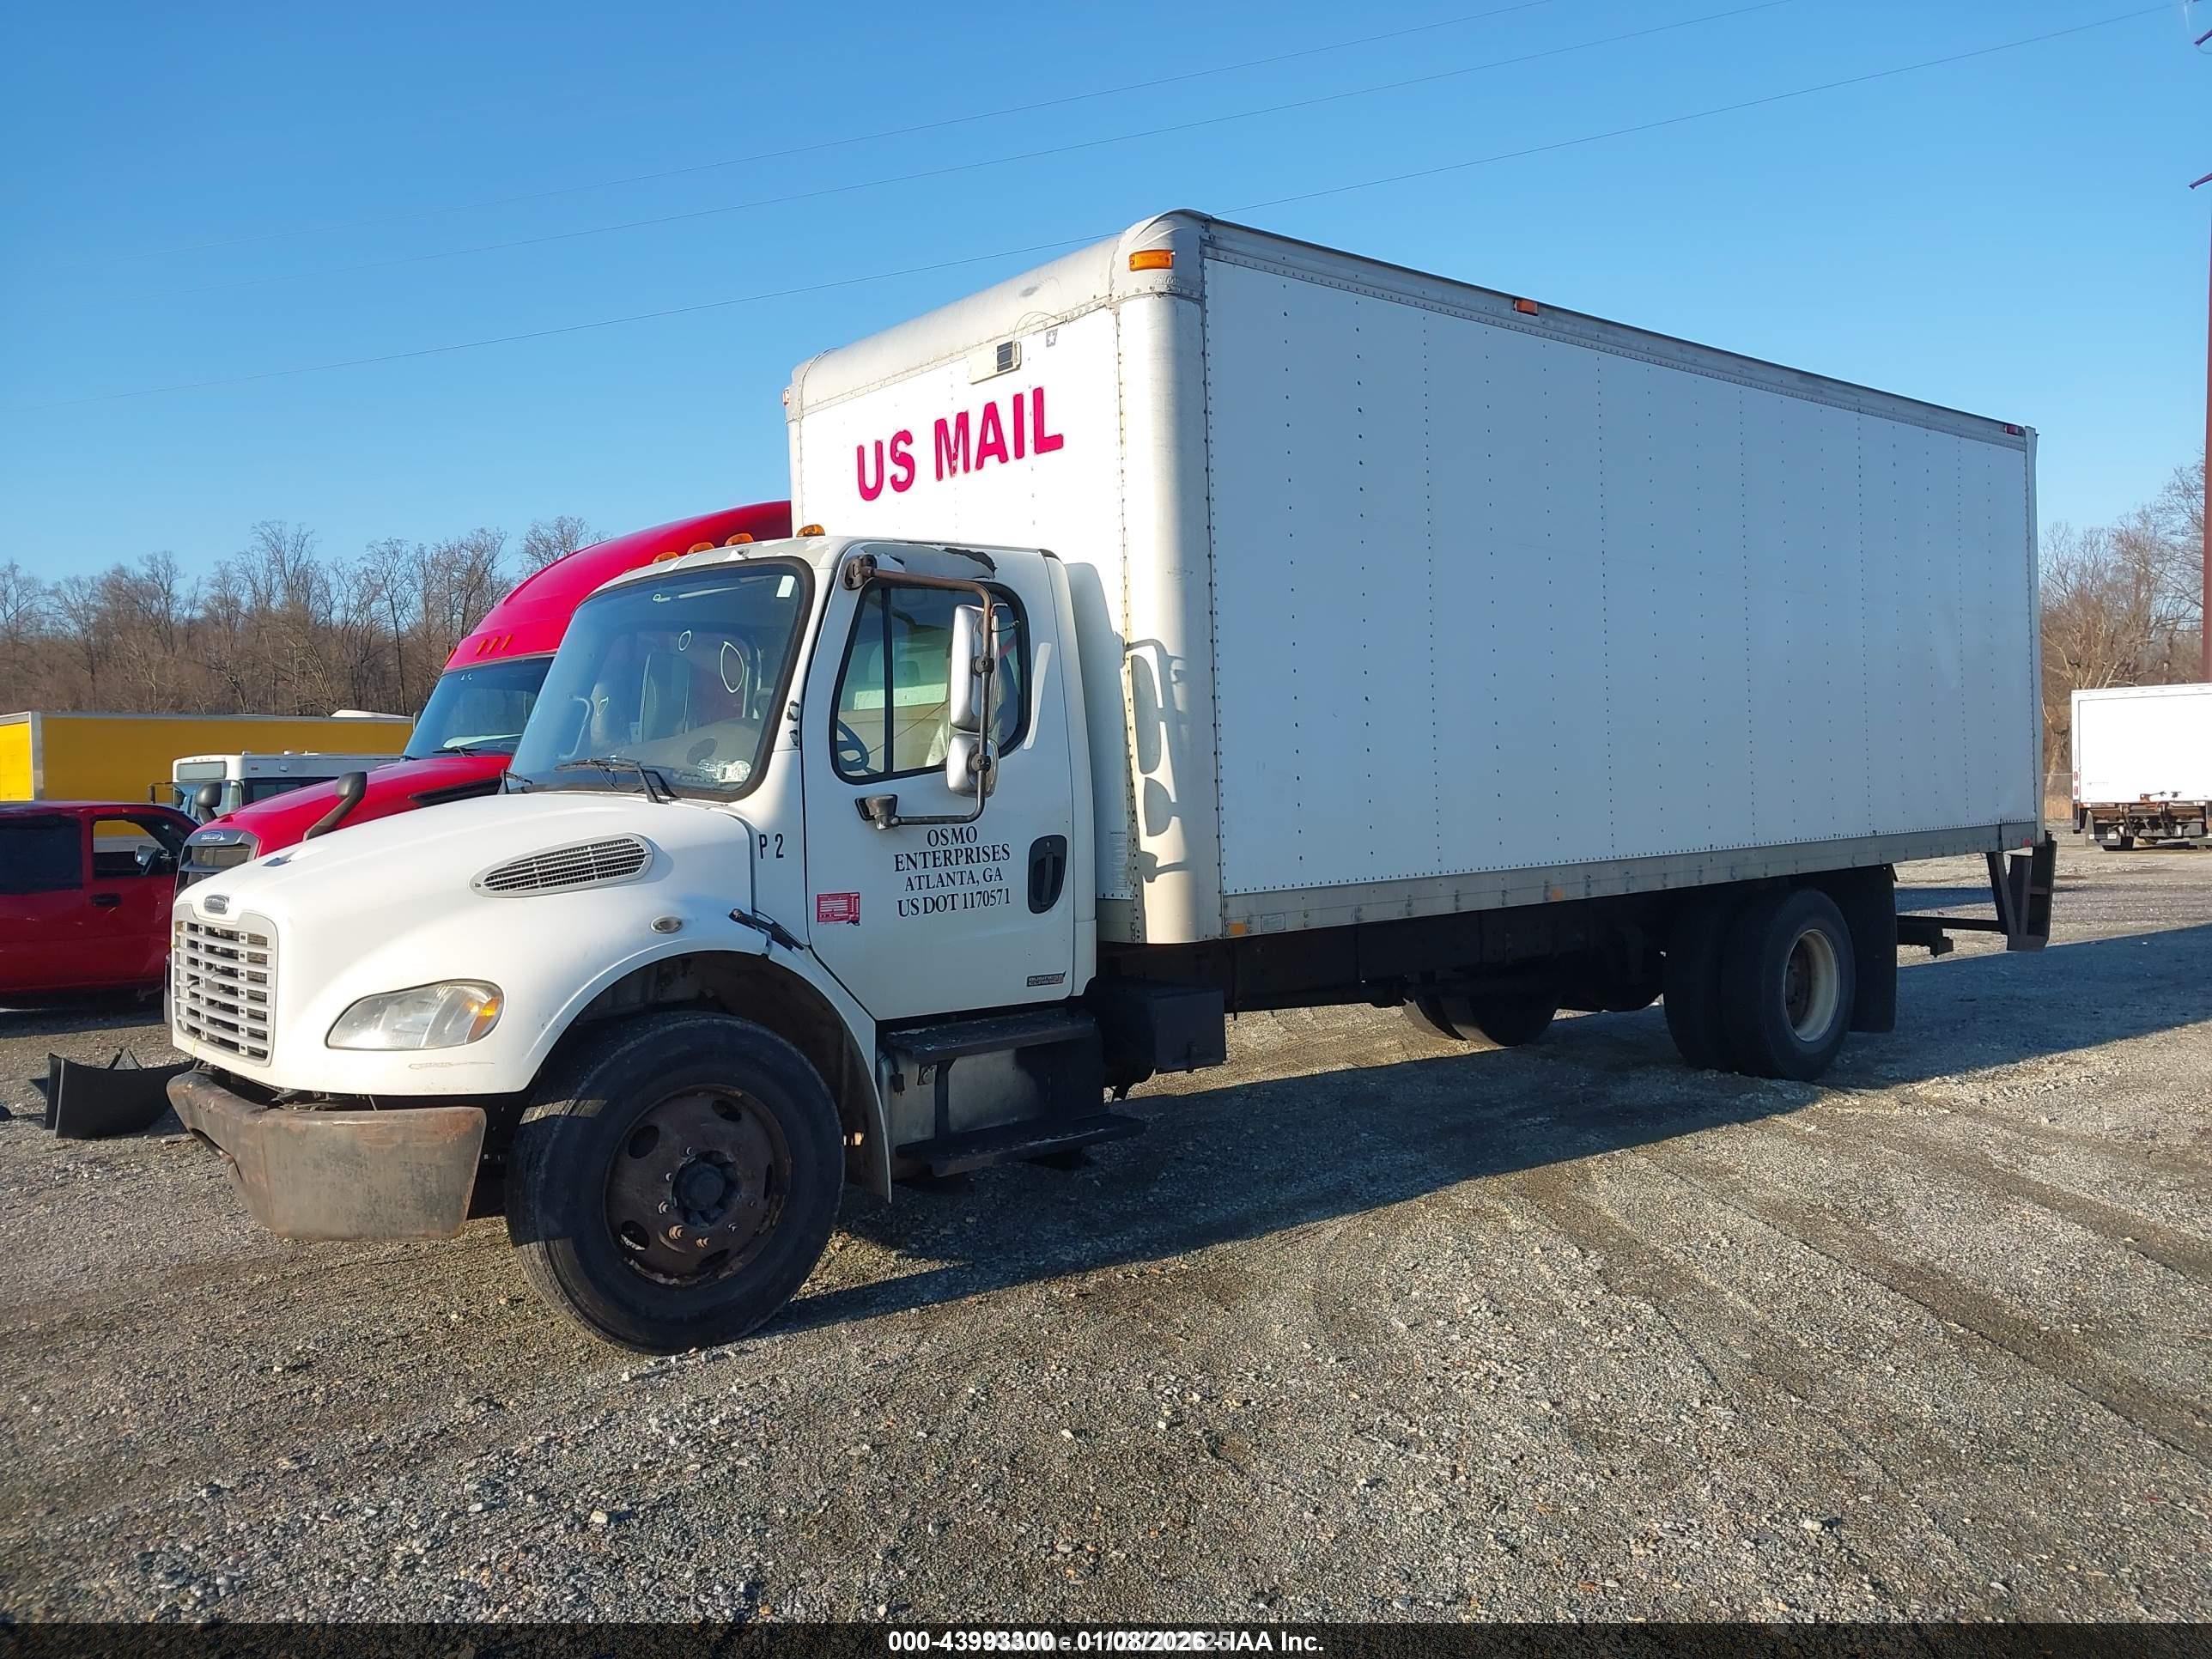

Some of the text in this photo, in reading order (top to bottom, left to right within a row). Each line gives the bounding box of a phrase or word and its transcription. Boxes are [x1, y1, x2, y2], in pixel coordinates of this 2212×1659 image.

[857, 386, 1065, 501] US MAIL
[758, 833, 785, 860] P 2
[927, 825, 978, 848] OSMO
[894, 843, 1011, 872] ENTERPRISES
[904, 866, 1004, 892] ATLANTA, GA
[896, 887, 1011, 917] US DOT 1170571
